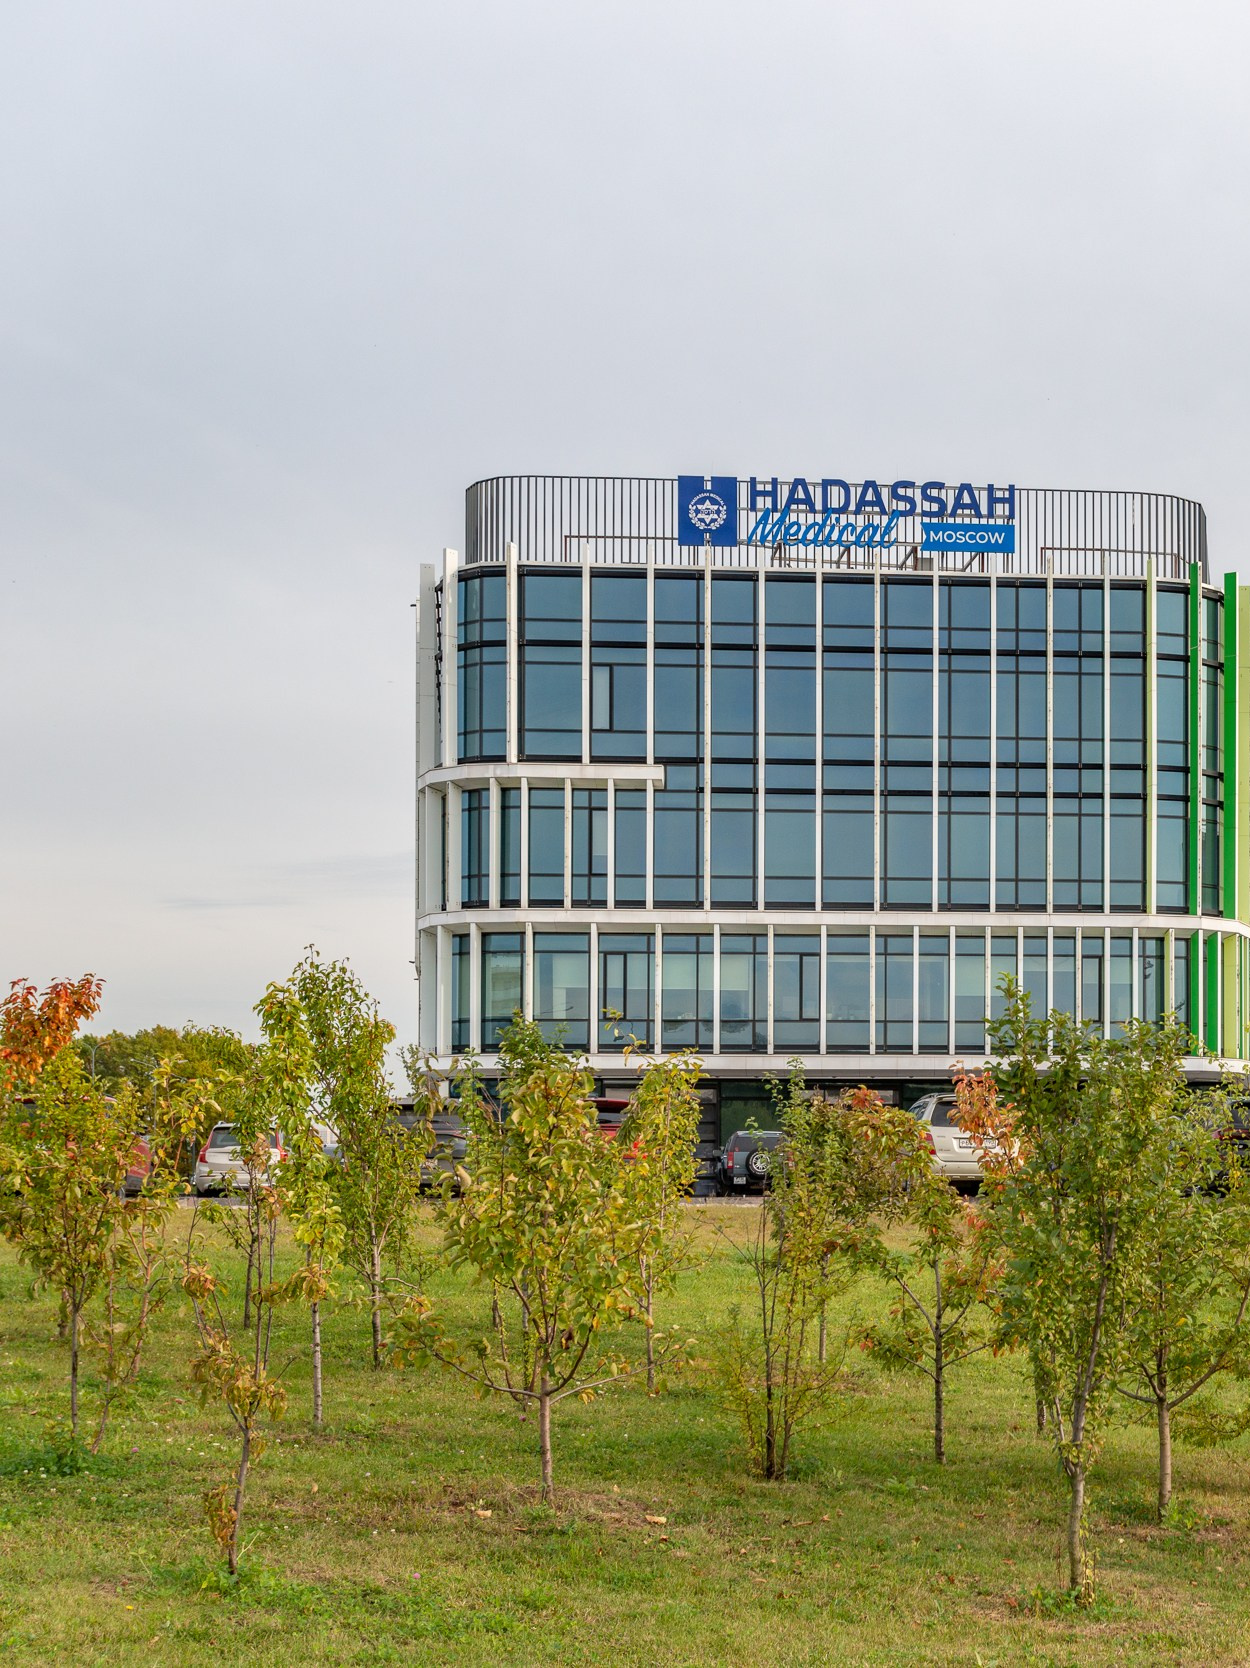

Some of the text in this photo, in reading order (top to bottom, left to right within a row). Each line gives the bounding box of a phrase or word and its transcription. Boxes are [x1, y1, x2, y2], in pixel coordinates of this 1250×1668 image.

[749, 476, 1015, 519] HADASSAH
[747, 507, 900, 549] Medical
[929, 530, 1005, 545] MOSCOW
